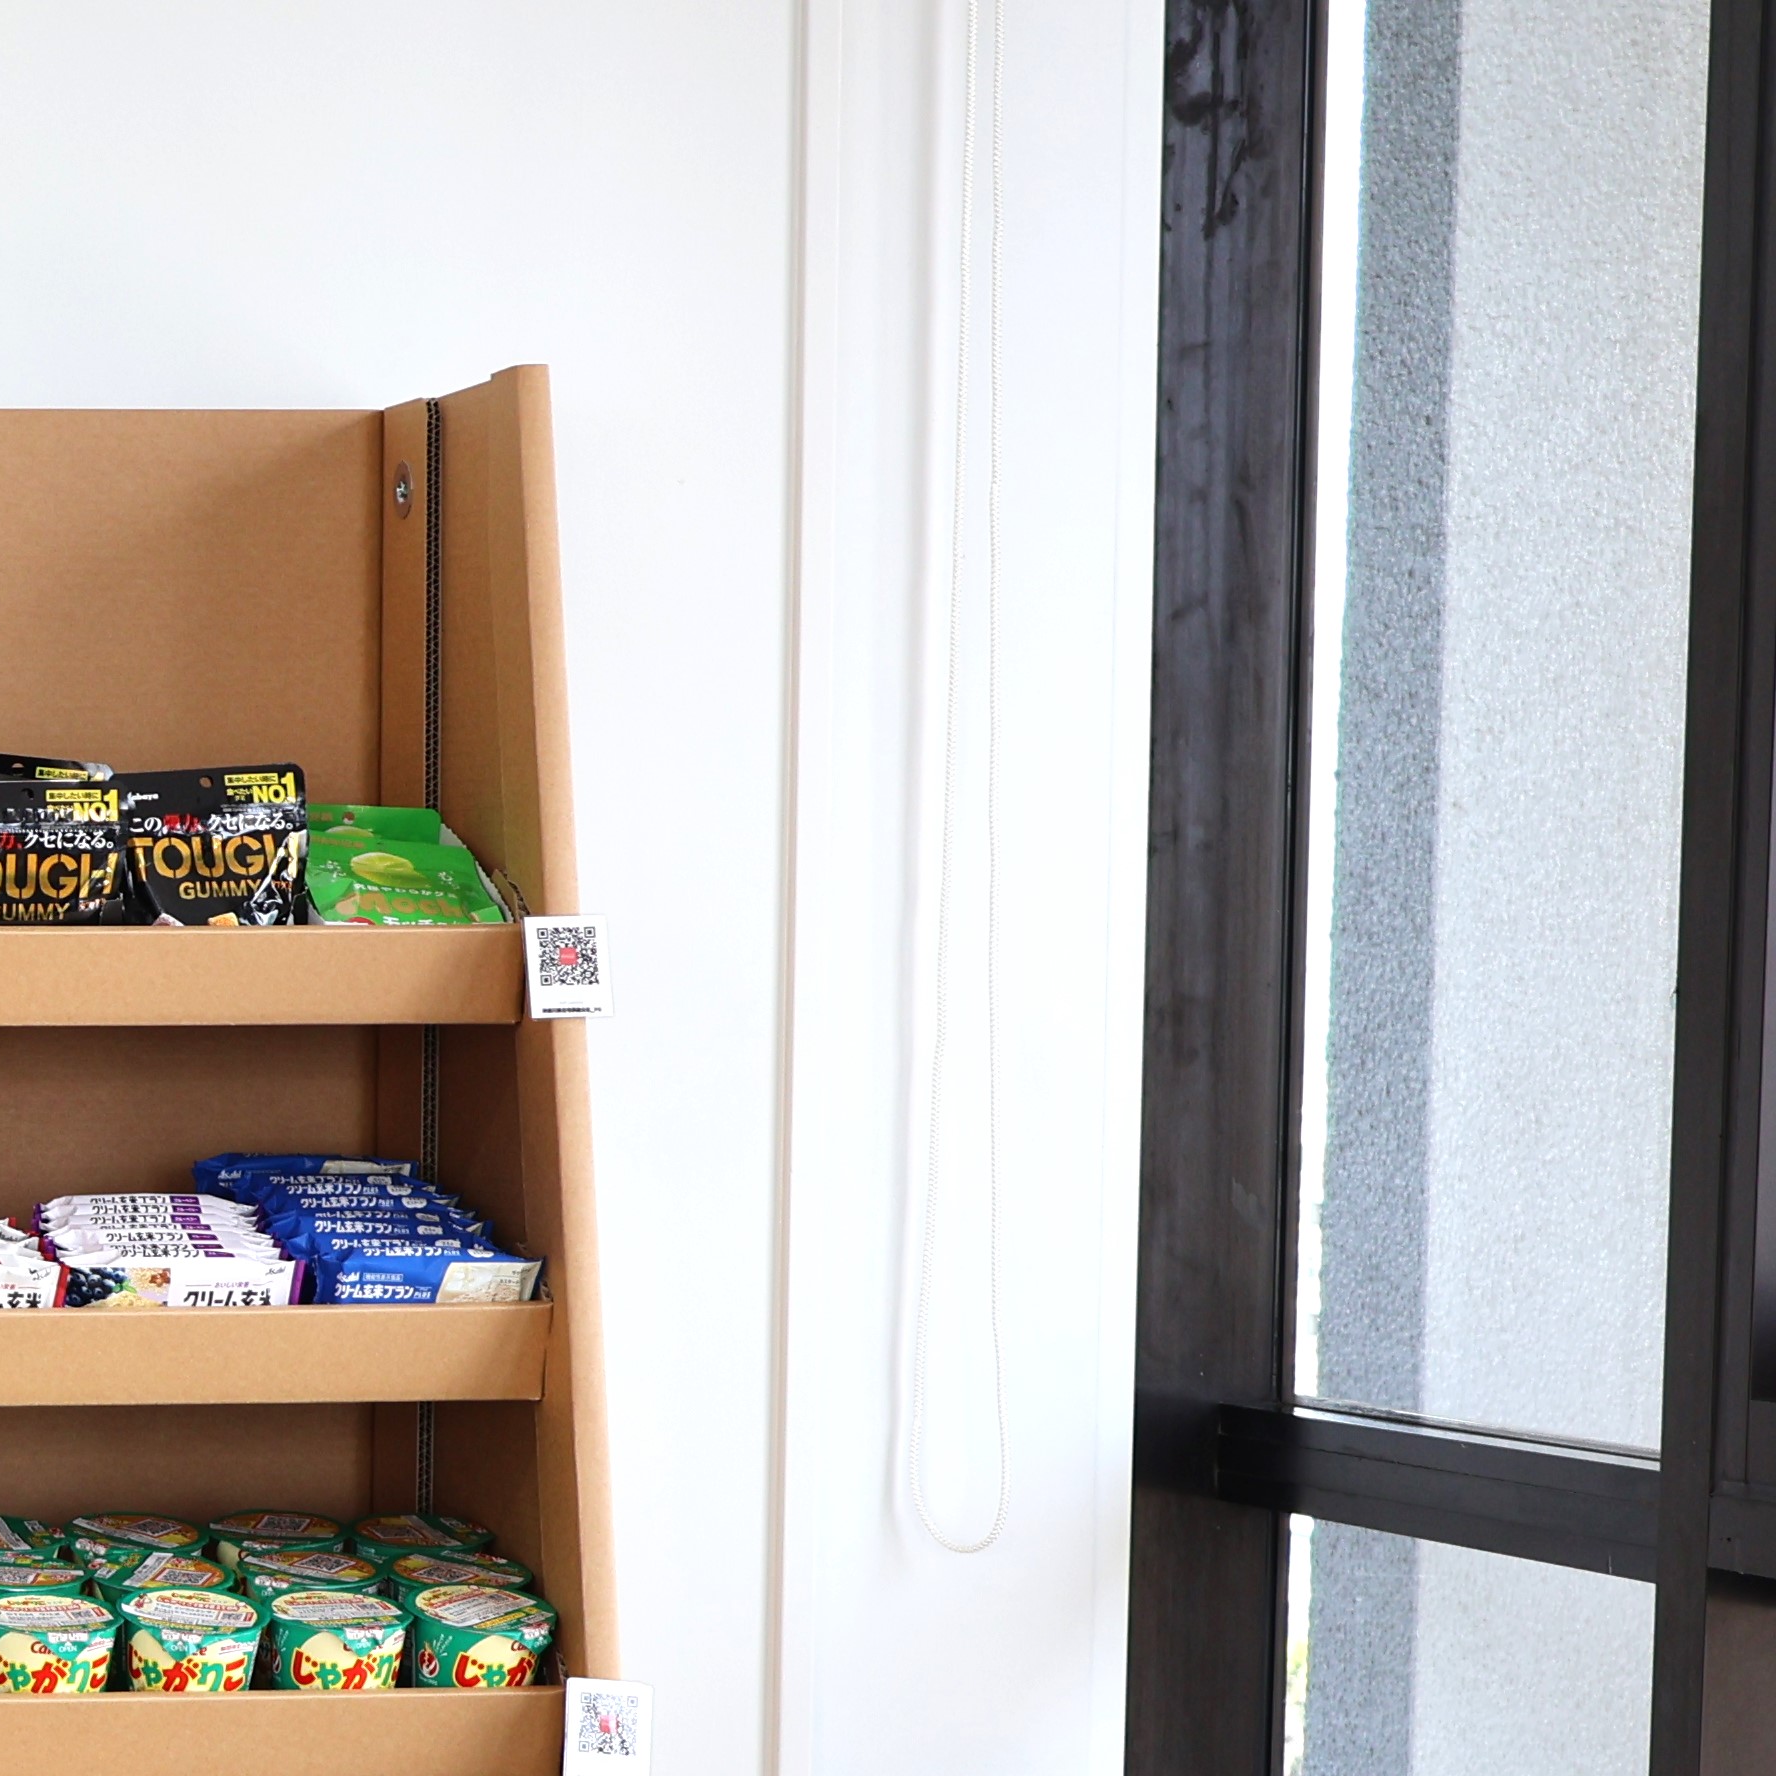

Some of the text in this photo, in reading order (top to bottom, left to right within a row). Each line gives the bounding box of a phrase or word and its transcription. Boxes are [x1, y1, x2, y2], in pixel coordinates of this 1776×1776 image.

[128, 833, 304, 882] TOUGH
[178, 880, 259, 899] GUMMY
[106, 1233, 183, 1241] クリーム玄米ブラン
[128, 1645, 248, 1691] じゃがりこ
